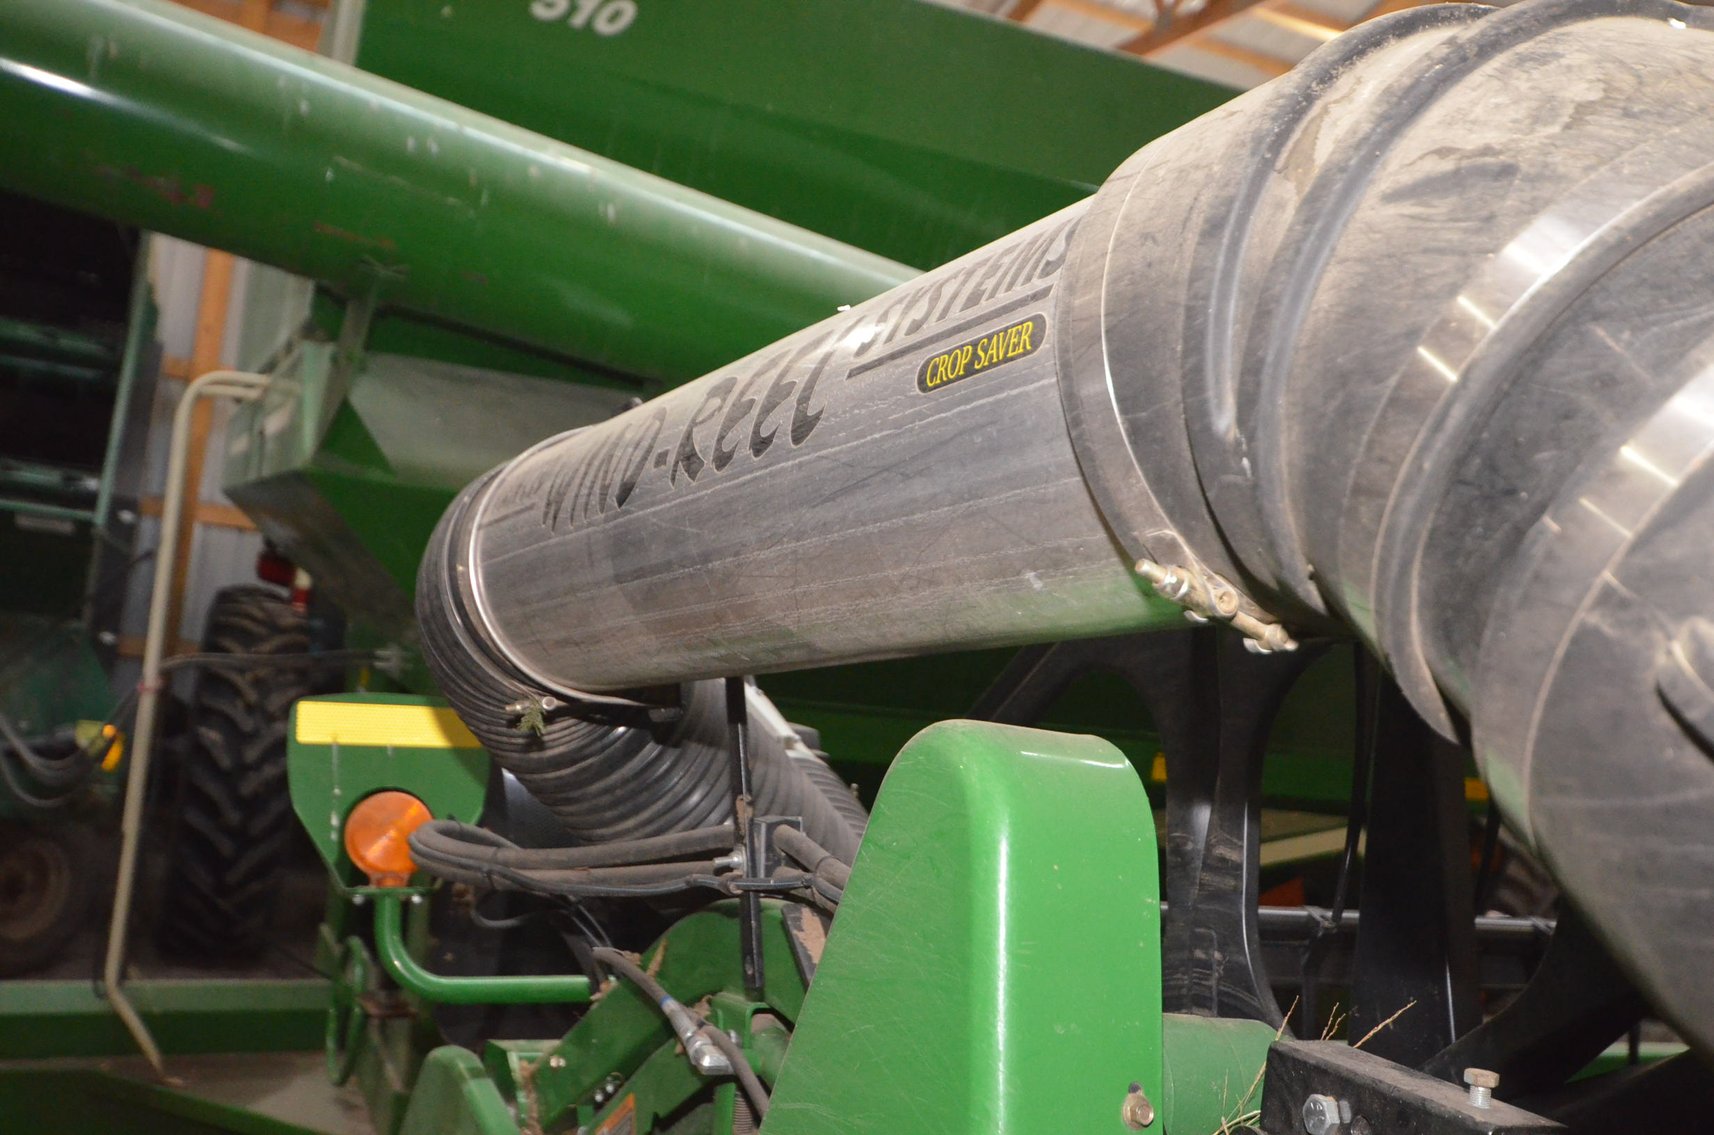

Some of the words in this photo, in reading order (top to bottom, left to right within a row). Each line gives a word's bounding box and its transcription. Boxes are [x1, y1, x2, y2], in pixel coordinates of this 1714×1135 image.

[853, 216, 1083, 358] SYSTEMS
[926, 345, 973, 387] CROP
[974, 321, 1033, 369] SAVER
